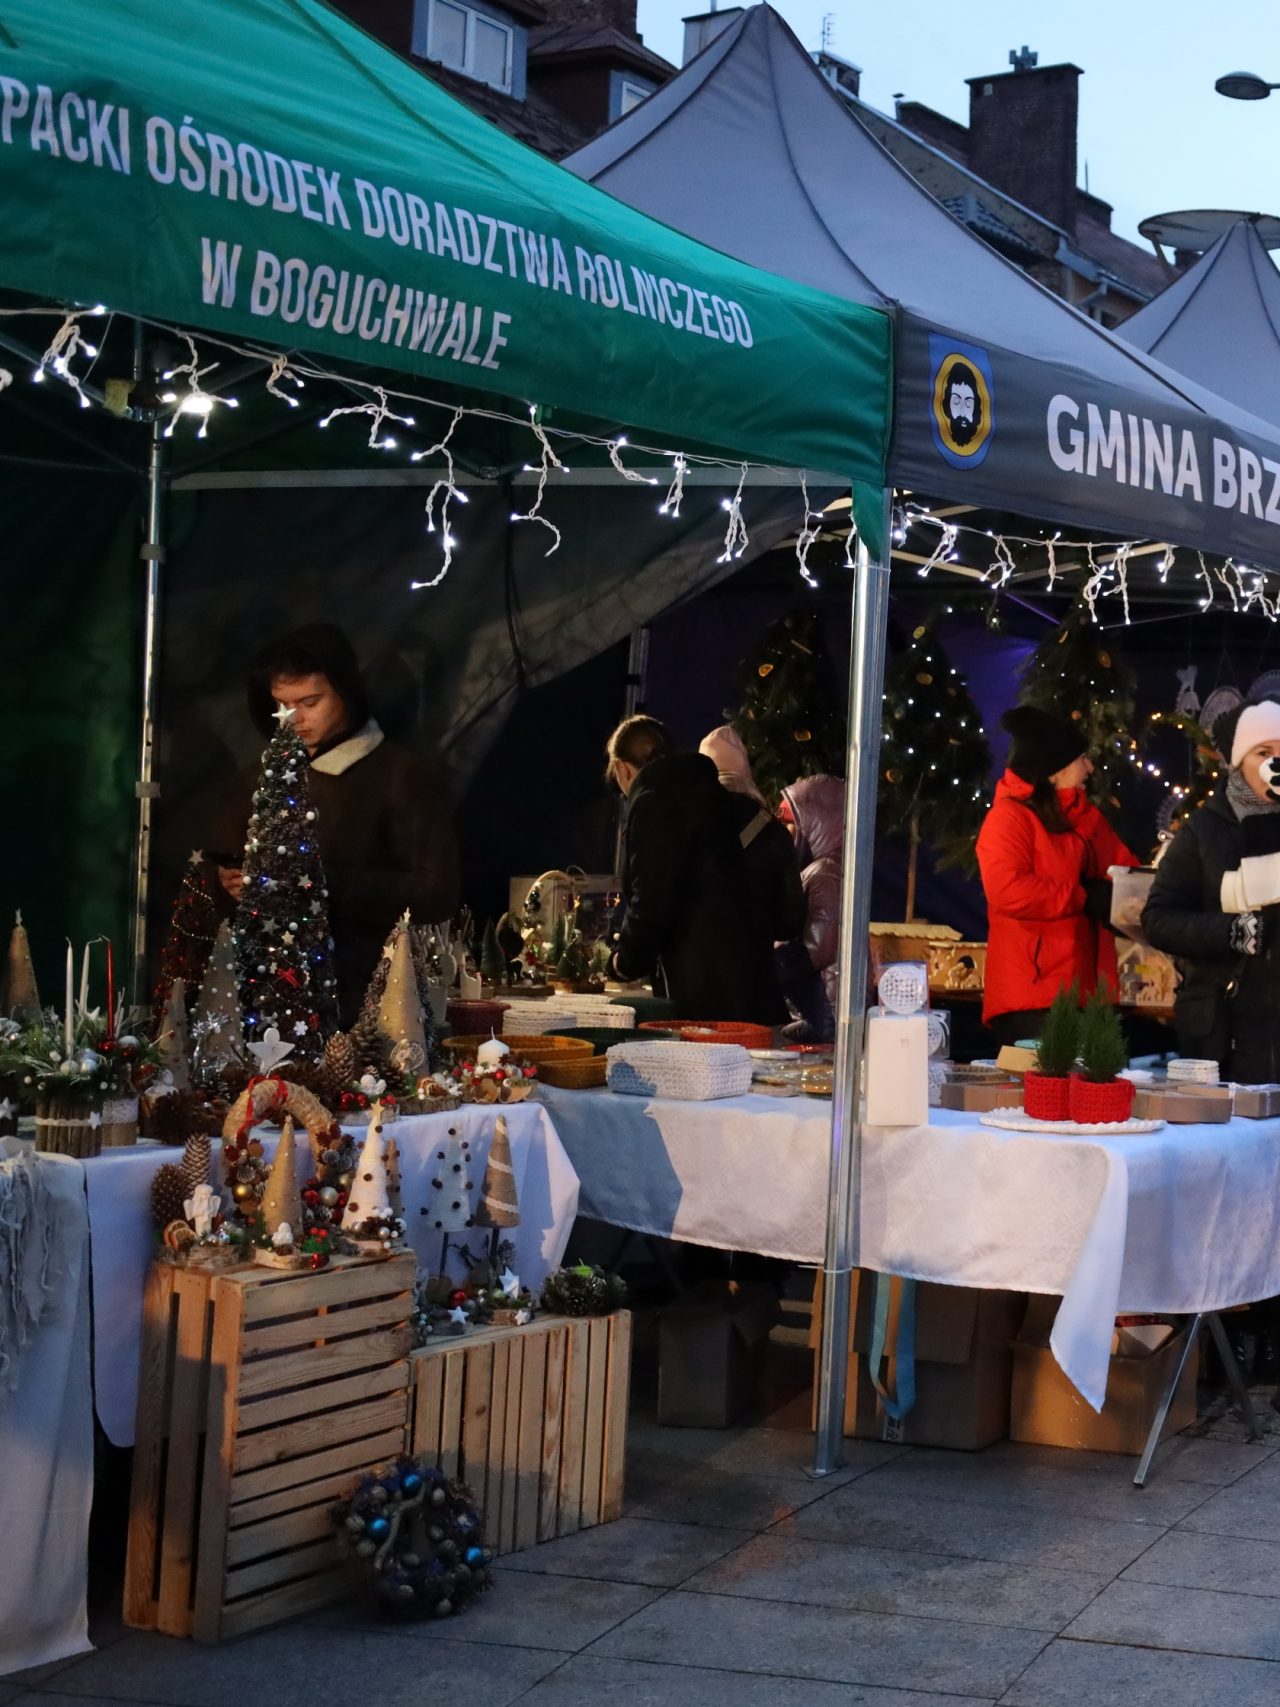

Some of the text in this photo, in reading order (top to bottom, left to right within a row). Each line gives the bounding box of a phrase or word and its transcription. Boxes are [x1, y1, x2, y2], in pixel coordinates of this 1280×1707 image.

[0, 75, 754, 349] PACKI OŚRODEK DORADZTWA ROLNICZEGO
[201, 236, 512, 369] W BOGUCHWALE
[1047, 394, 1203, 502] GMINA
